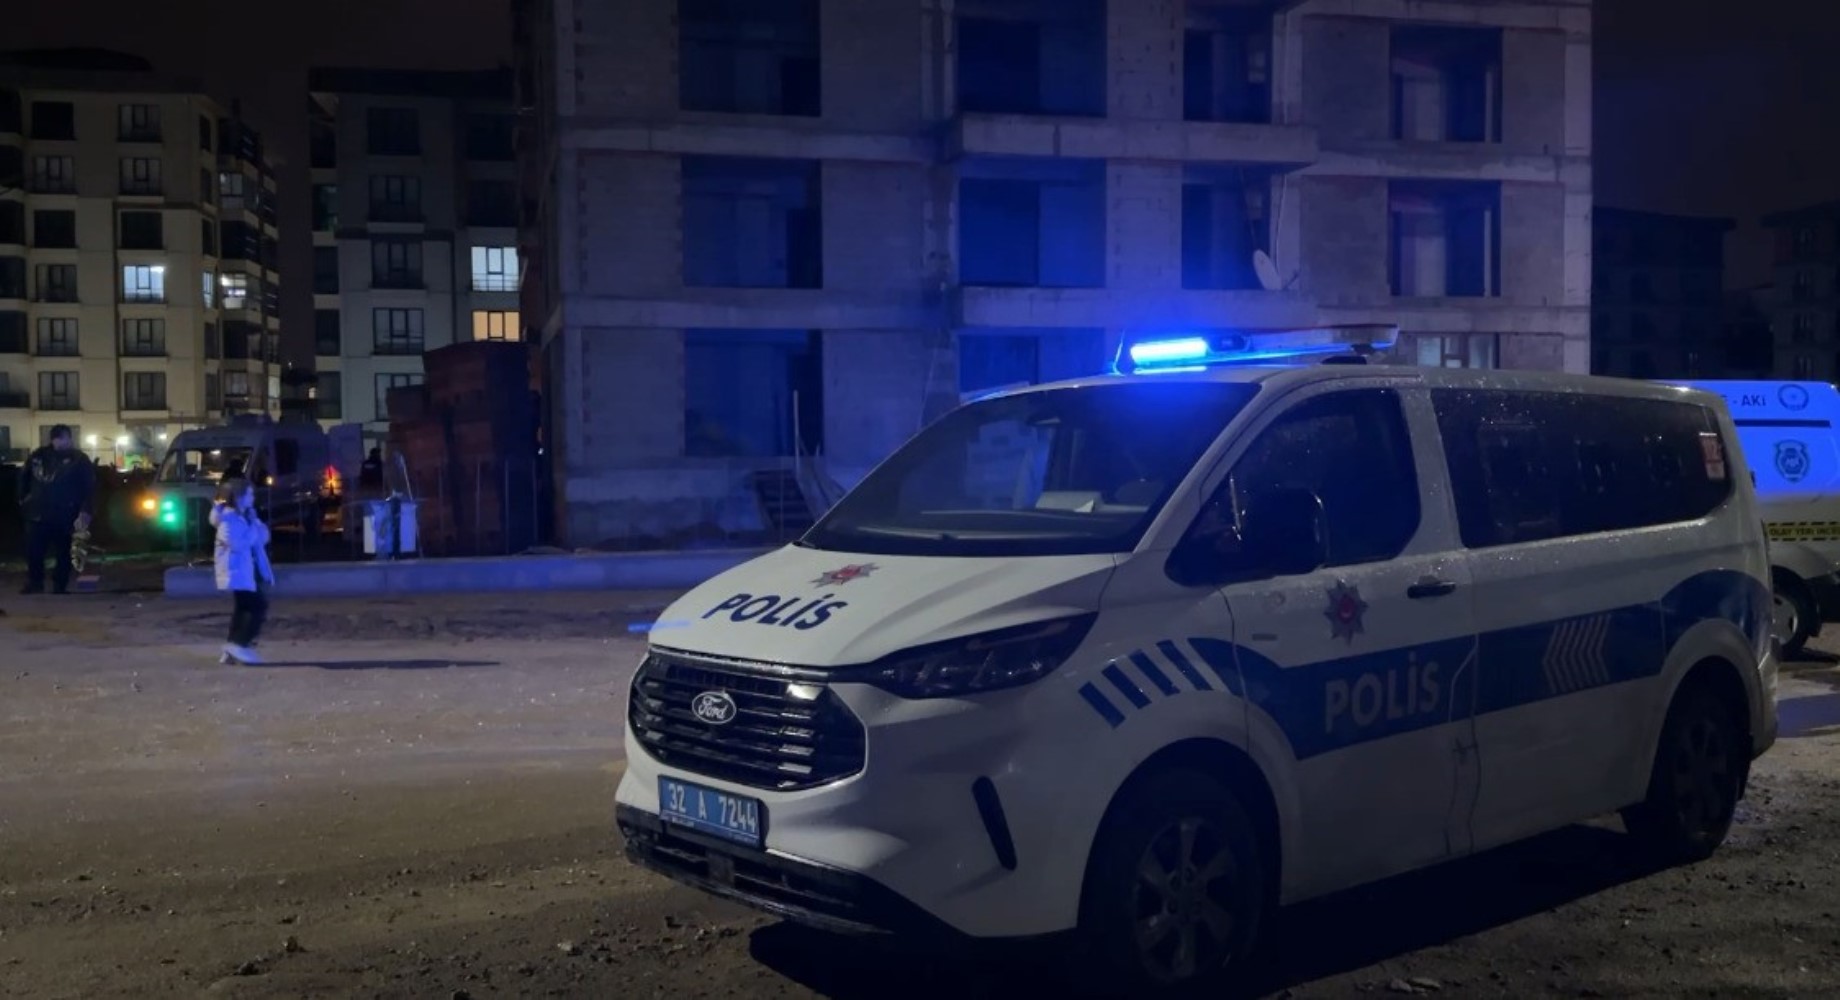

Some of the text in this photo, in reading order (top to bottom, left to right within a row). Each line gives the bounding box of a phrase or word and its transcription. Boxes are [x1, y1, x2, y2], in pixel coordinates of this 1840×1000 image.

[701, 593, 848, 630] POLİS
[698, 695, 728, 719] Ford
[1325, 650, 1440, 734] POLİS
[668, 783, 686, 814] 32
[698, 790, 707, 820] A
[718, 795, 756, 833] 7244
